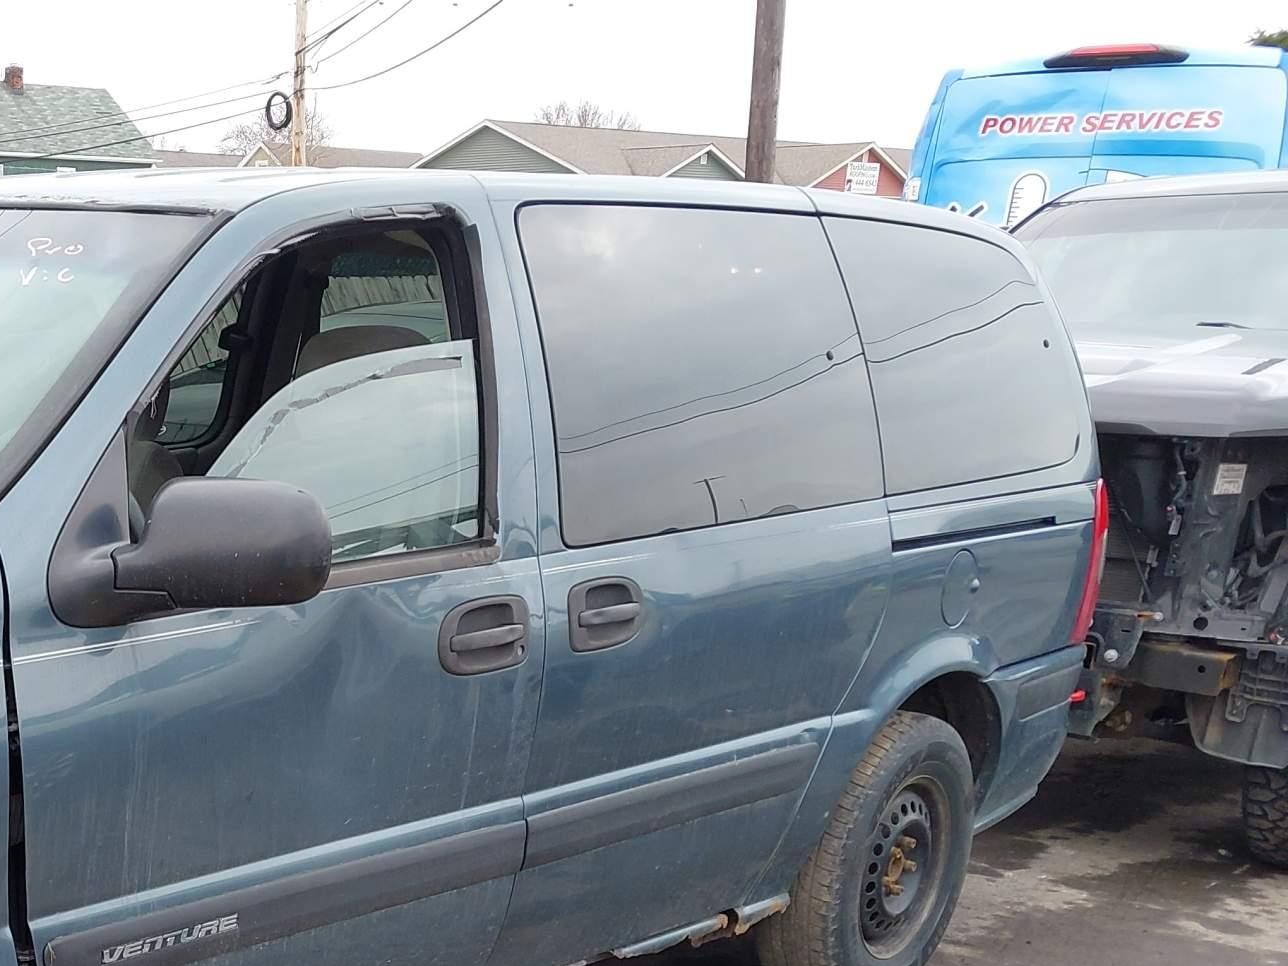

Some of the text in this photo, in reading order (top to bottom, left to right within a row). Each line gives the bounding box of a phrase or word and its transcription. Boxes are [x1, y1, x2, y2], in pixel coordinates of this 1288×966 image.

[981, 110, 1223, 135] POWER SERVICES
[101, 912, 239, 964] VENTURE
